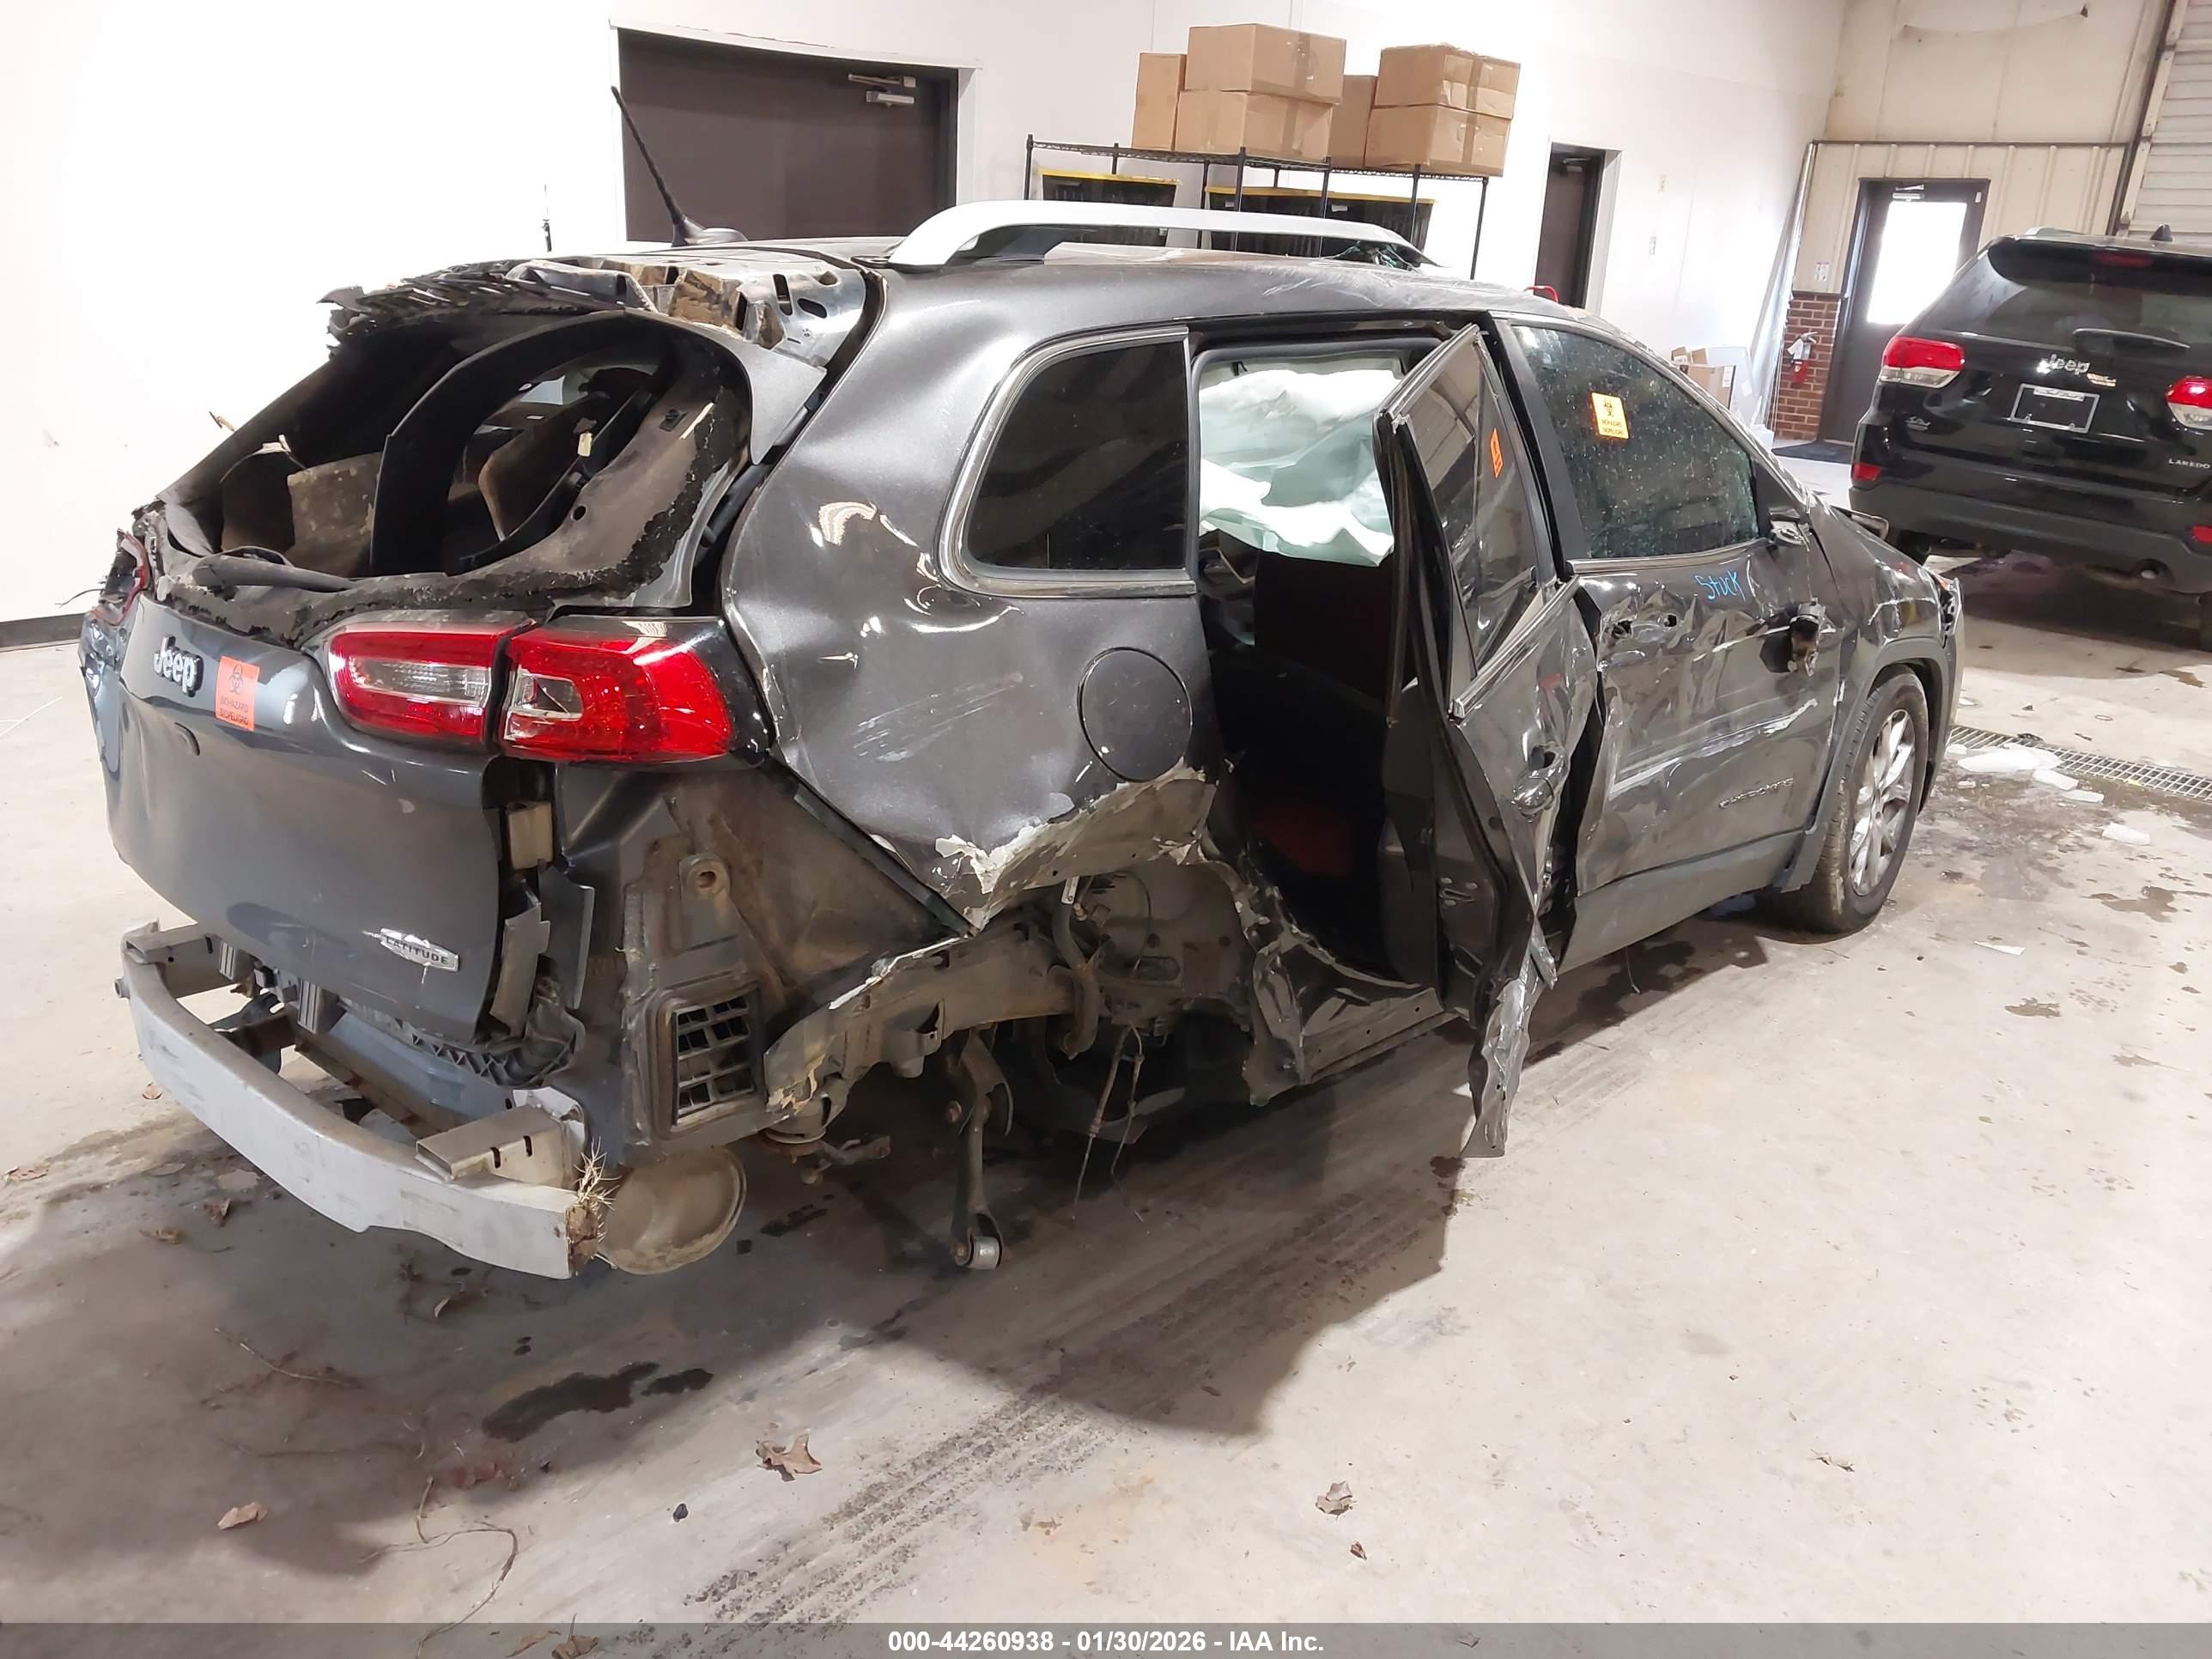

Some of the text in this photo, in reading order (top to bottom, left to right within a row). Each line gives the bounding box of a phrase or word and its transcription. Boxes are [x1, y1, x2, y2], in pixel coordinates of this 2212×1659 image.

[2040, 353, 2090, 375] Jeep
[2168, 458, 2211, 469] LAREDO
[154, 635, 202, 695] Jeep
[386, 936, 448, 965] LATITUDE
